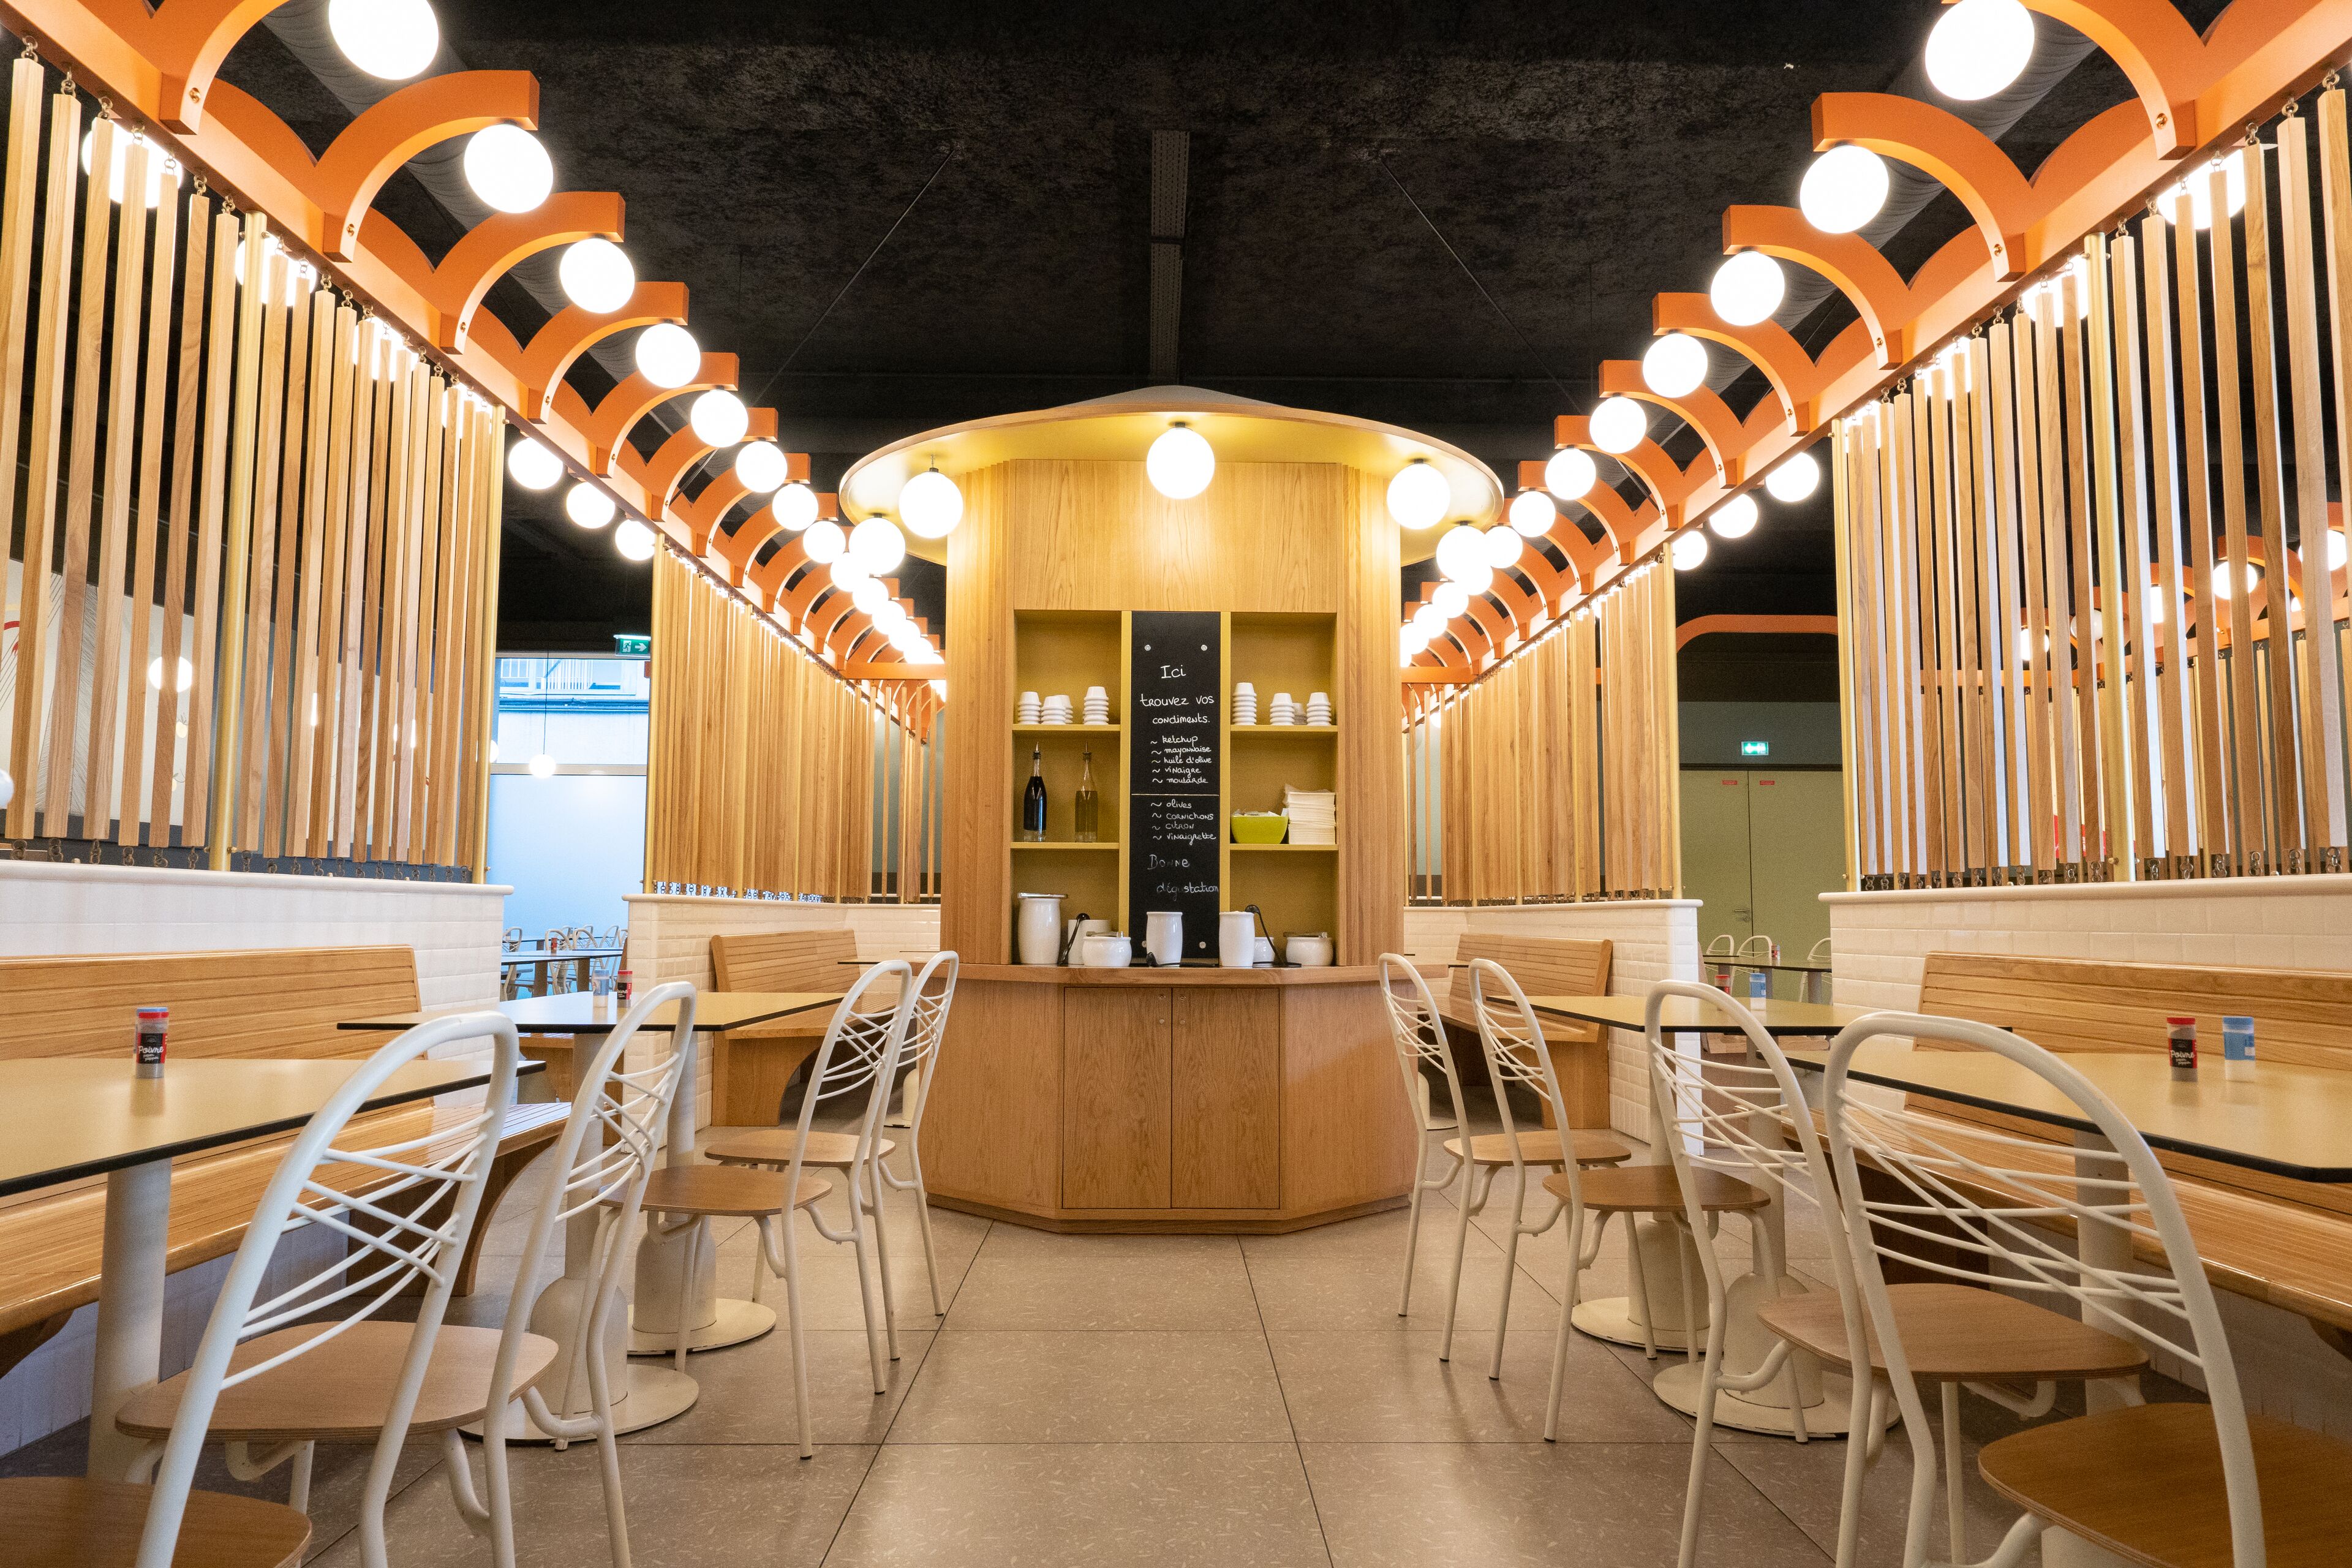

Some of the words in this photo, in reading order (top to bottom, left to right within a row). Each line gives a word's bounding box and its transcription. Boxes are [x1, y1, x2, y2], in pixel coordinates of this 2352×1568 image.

[1161, 665, 1186, 679] Ici
[1140, 693, 1189, 706] trouvez
[1196, 695, 1215, 704] vos
[1152, 712, 1210, 724] condiments.
[1162, 735, 1198, 747] ketchup
[1164, 745, 1212, 758] mayonnaise
[1165, 766, 1201, 778] vinaigre
[1166, 799, 1192, 808] olives
[1166, 821, 1194, 829] citron
[1167, 832, 1216, 845] vinaigrette
